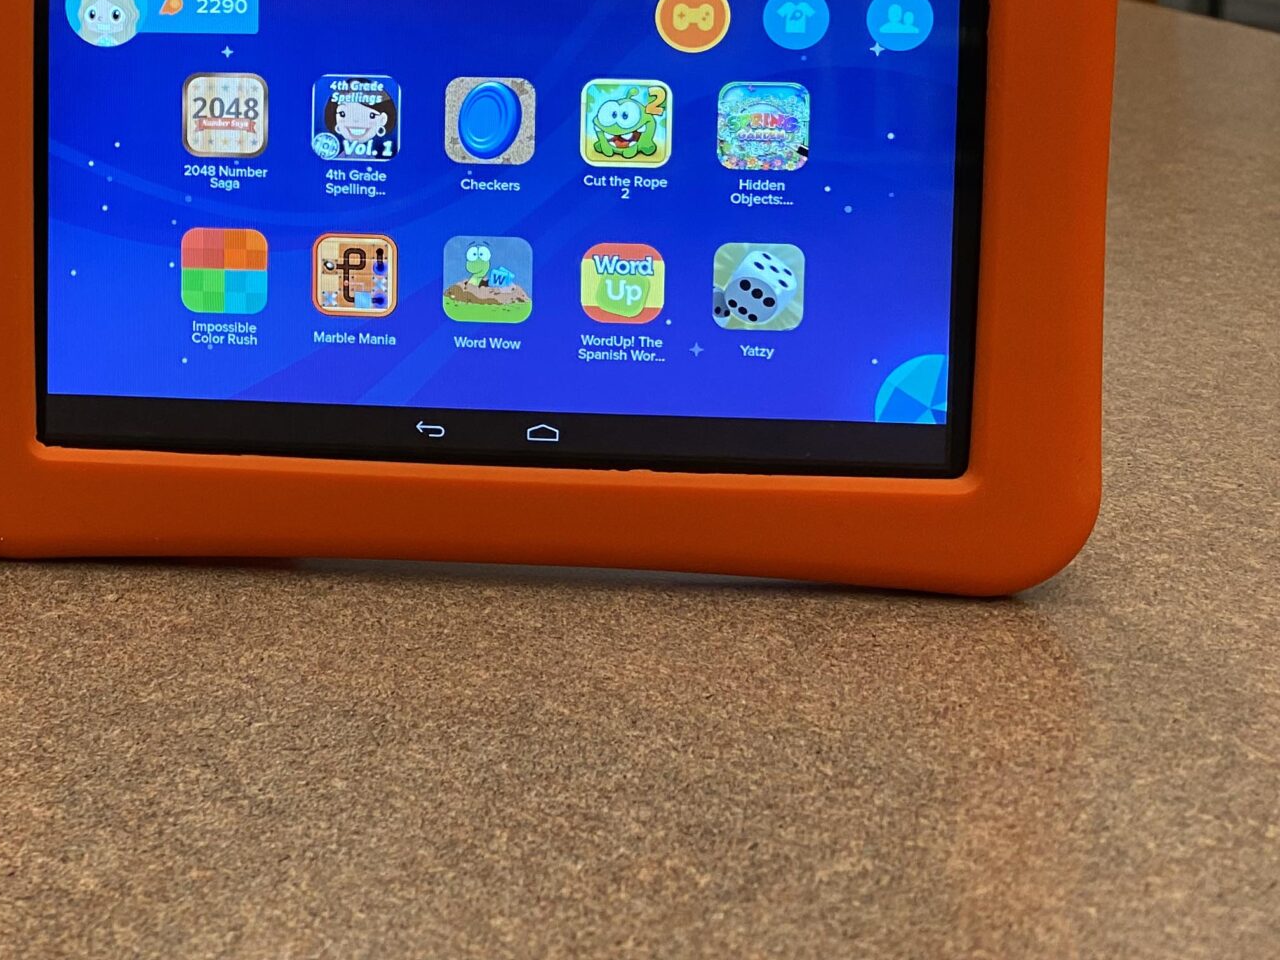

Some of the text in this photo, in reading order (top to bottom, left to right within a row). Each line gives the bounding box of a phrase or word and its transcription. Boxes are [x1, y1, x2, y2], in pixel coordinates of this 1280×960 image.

[330, 80, 384, 91] 4th Grade
[331, 92, 382, 105] Spellings
[645, 86, 668, 115] 2
[192, 96, 259, 120] 2048
[343, 139, 393, 157] Vol. 1
[183, 164, 268, 178] 2048 Number
[326, 169, 387, 182] 4th Grade
[210, 178, 240, 191] Saga
[325, 182, 386, 198] Spelling...
[460, 178, 521, 192] Checkers
[583, 175, 668, 191] Cut the Rope
[738, 178, 786, 192] Hidden
[620, 187, 630, 200] 2
[593, 254, 654, 276] Word
[492, 272, 507, 285] W
[605, 278, 643, 306] Up
[191, 320, 257, 336] Impossible
[191, 332, 258, 346] Color Rush
[313, 331, 397, 346] Marble Mania
[453, 336, 521, 350] Word Wow
[580, 334, 664, 349] WordUp! The
[578, 348, 666, 363] Spanish Wor...
[739, 344, 775, 359] Yatzy
